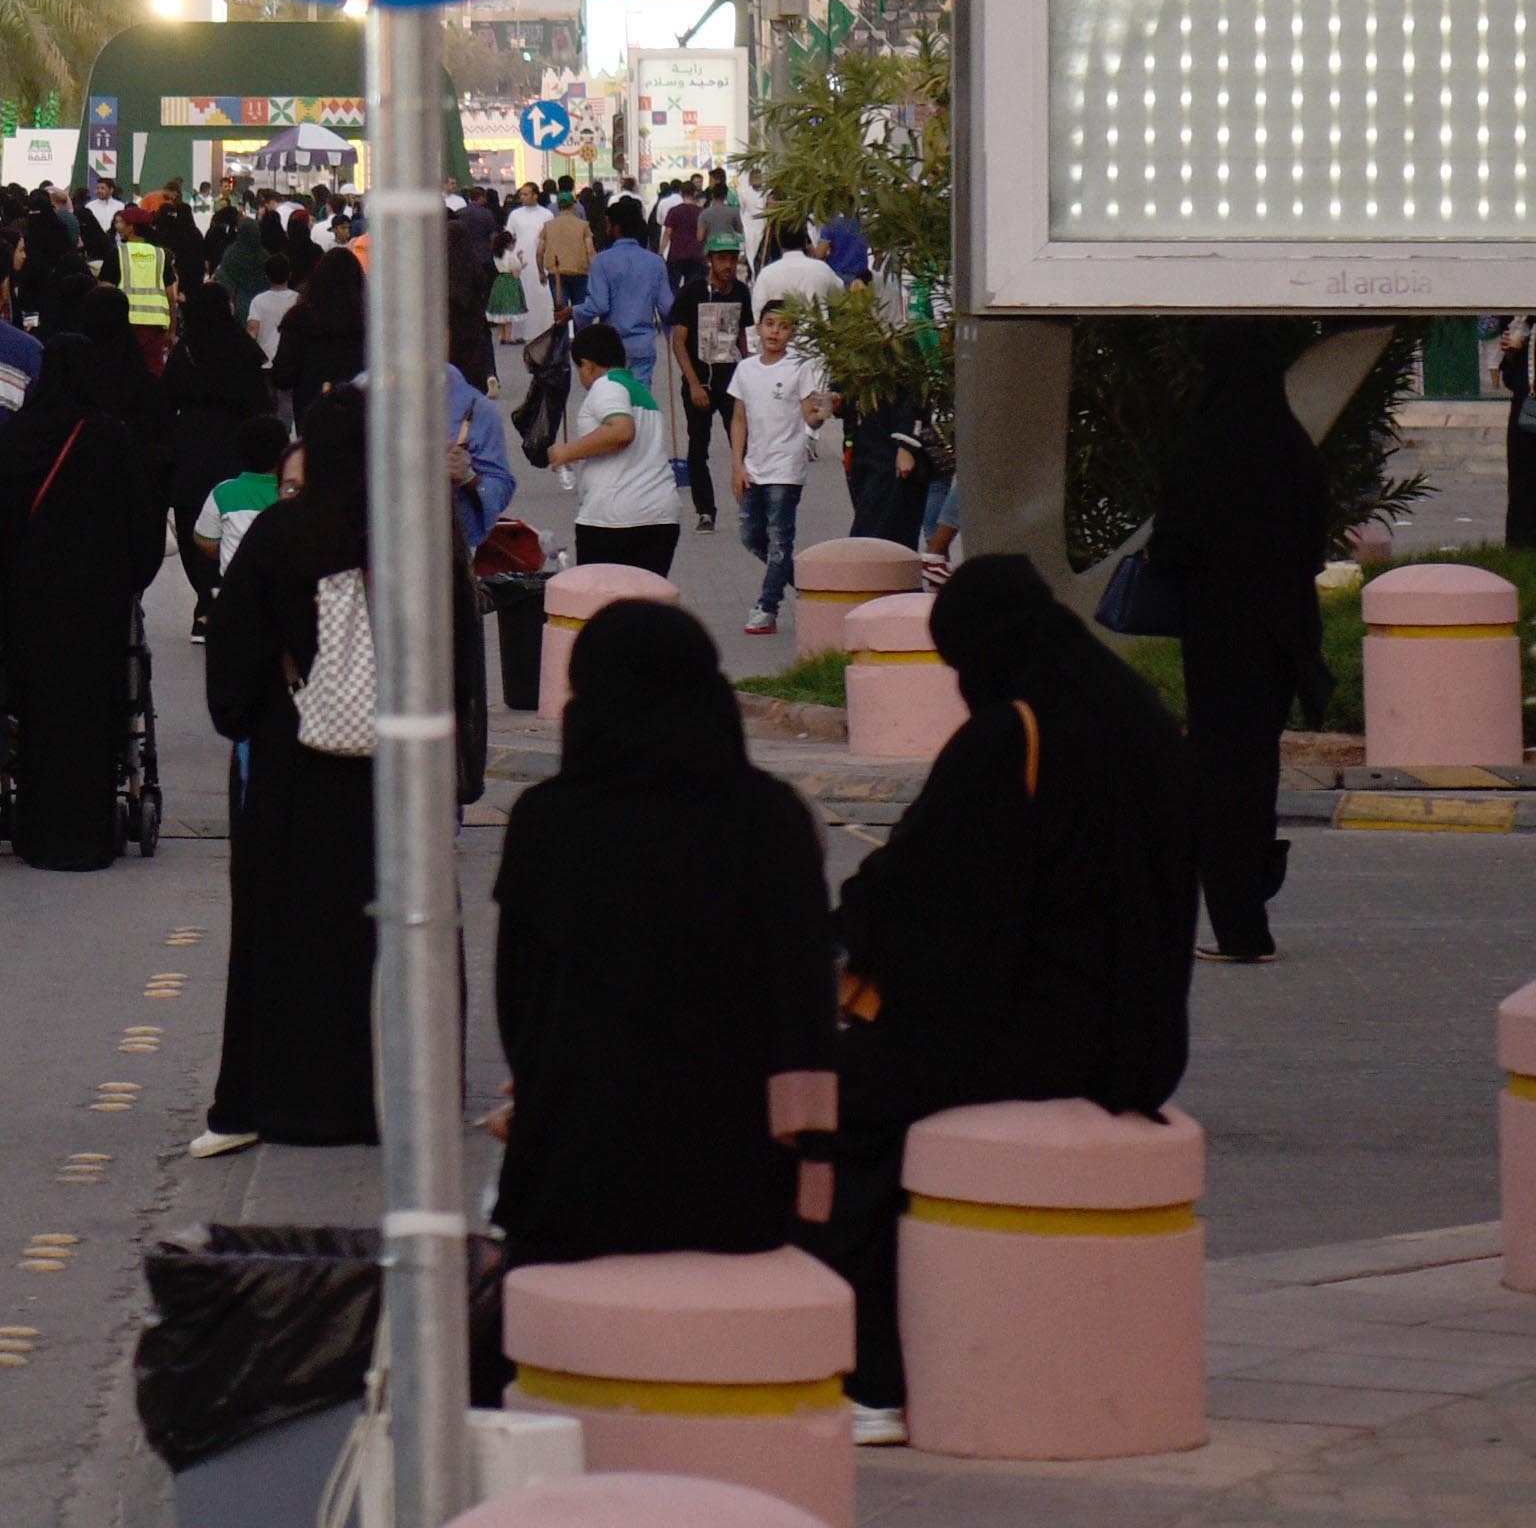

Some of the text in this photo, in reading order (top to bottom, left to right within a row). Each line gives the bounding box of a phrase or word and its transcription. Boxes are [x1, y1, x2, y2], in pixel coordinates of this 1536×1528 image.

[645, 76, 729, 89] توحيد وسلام
[1354, 269, 1432, 295] arabia
